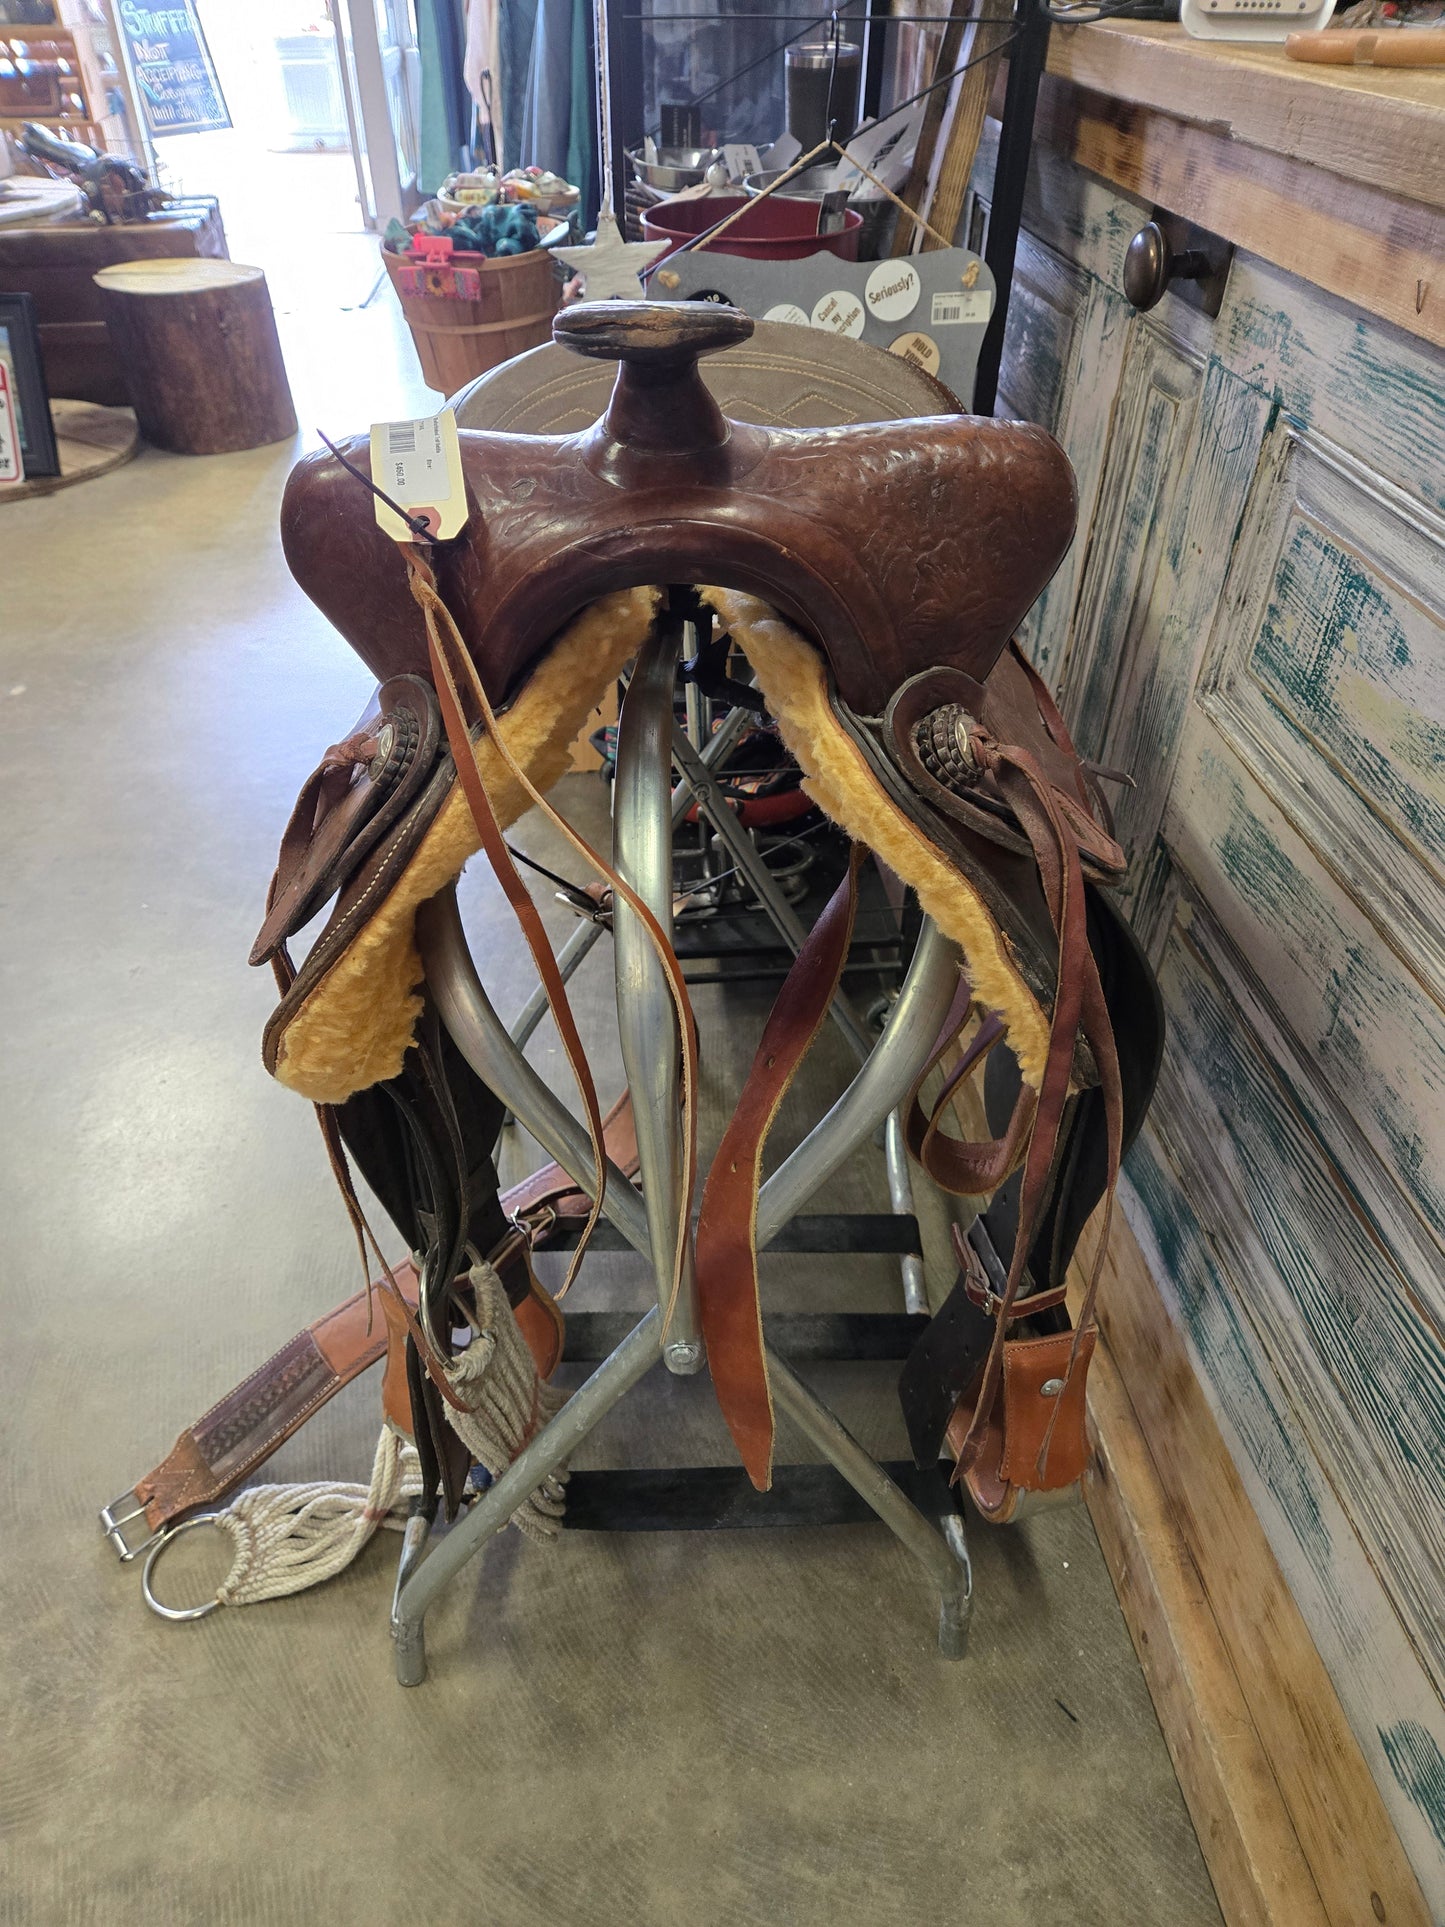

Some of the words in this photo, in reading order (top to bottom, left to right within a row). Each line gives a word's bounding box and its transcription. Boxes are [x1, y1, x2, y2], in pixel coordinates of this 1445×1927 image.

[868, 272, 915, 305] Seriously?
[818, 297, 838, 322] Cancel
[831, 312, 844, 325] my
[911, 337, 933, 359] HOLD
